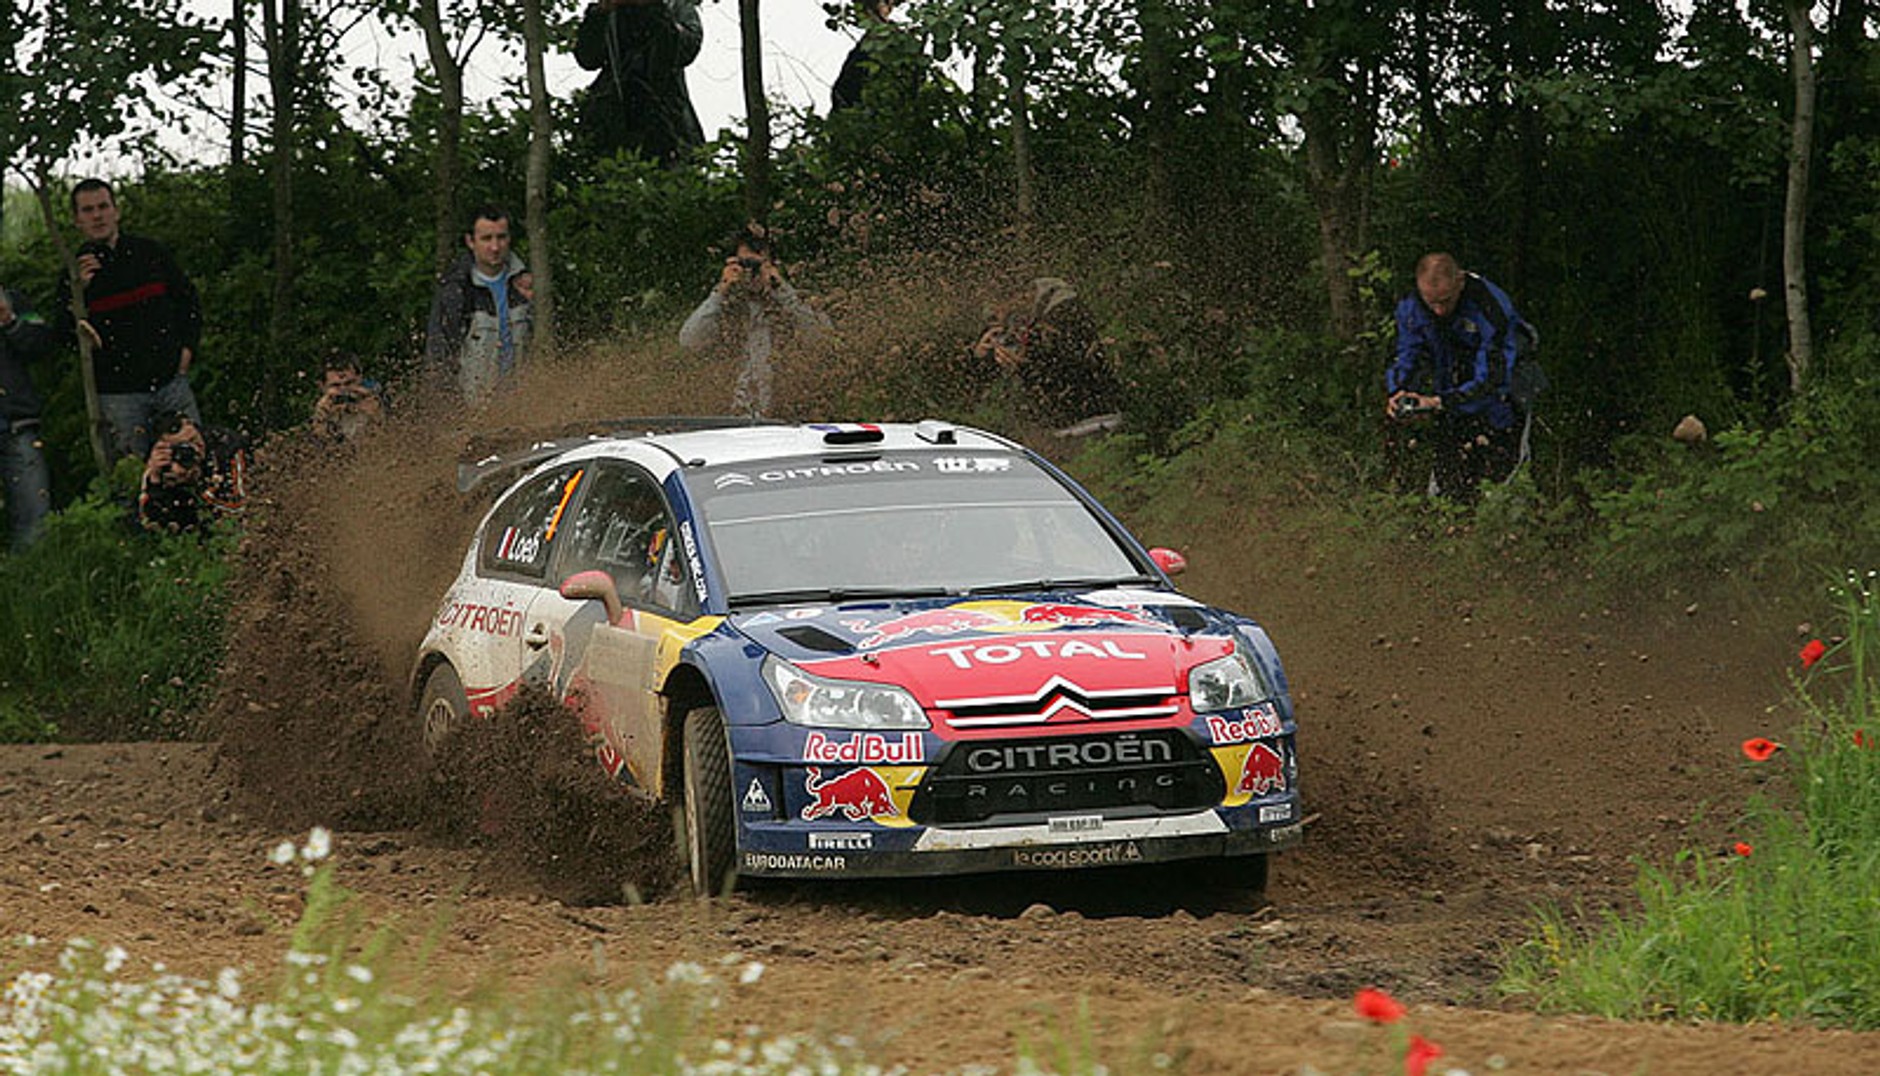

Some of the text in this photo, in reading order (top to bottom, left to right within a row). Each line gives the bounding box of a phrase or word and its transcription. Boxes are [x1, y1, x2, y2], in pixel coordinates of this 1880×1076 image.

[545, 469, 585, 541] 1
[508, 526, 541, 563] Loeb
[929, 640, 1146, 669] TOTAL
[1206, 709, 1258, 743] Red
[804, 732, 924, 762] Red Bull
[967, 734, 1172, 772] CITROËN
[745, 853, 846, 870] EURODATACAR
[1031, 850, 1067, 868] coq
